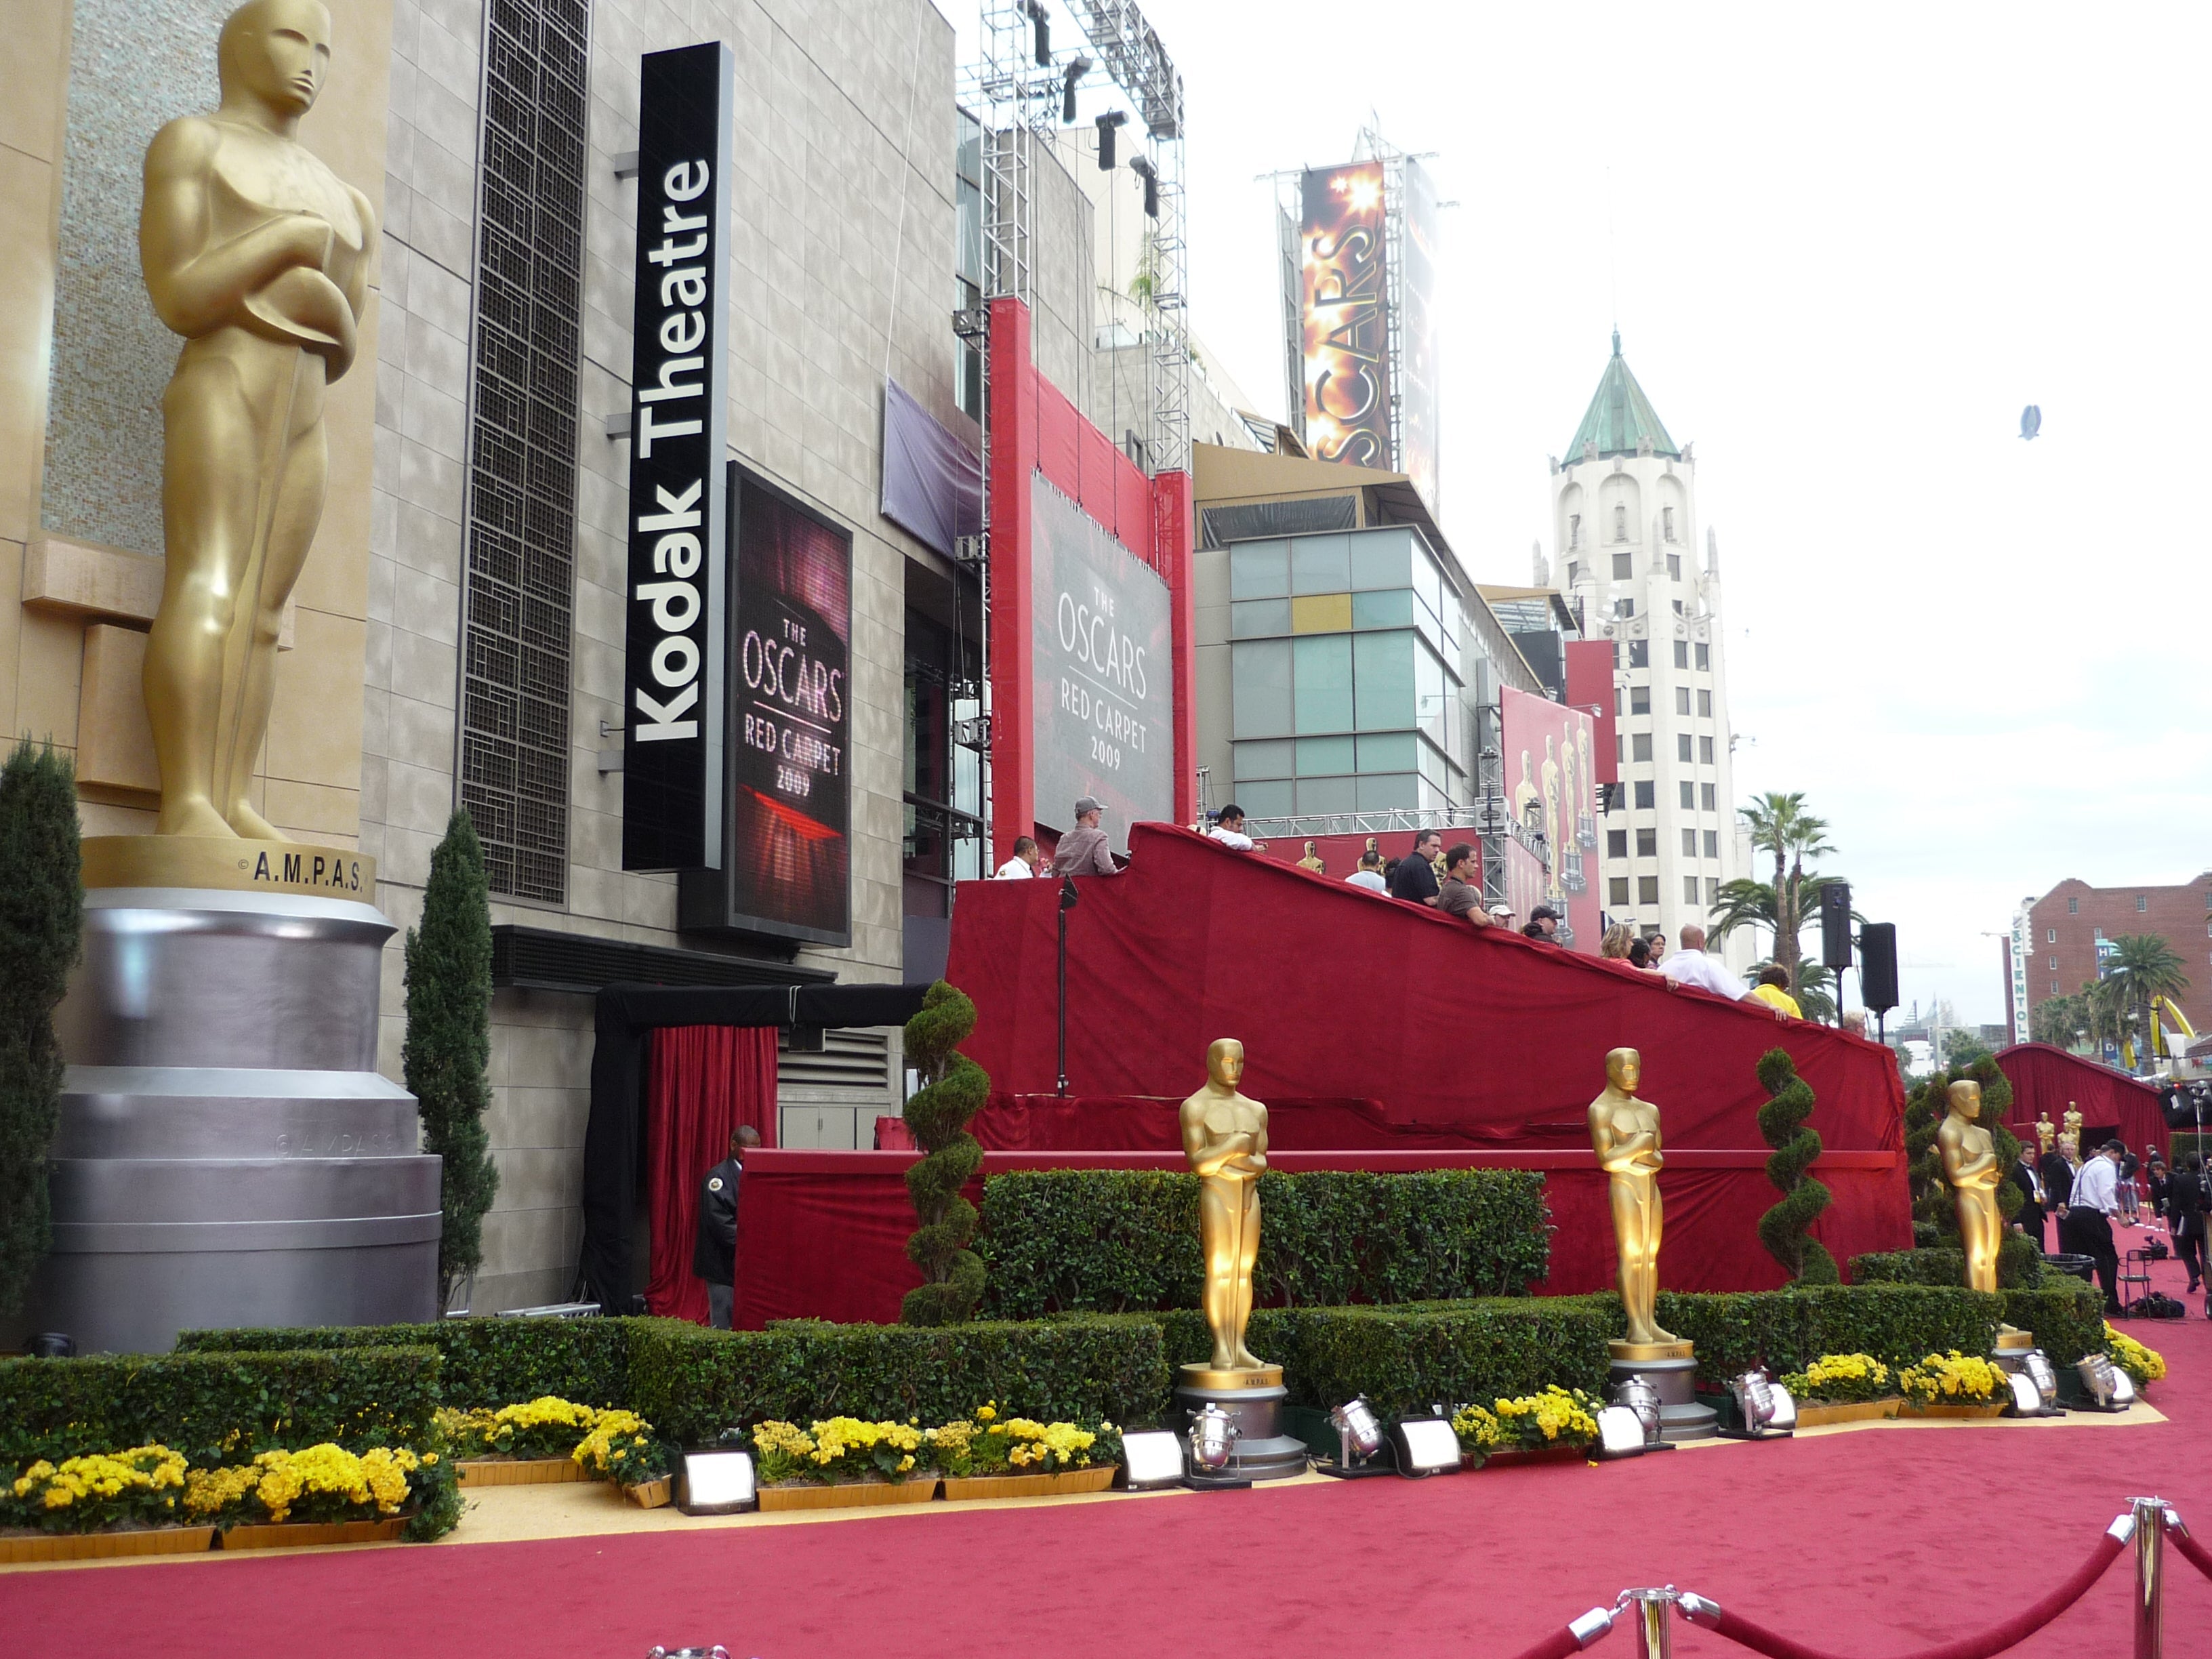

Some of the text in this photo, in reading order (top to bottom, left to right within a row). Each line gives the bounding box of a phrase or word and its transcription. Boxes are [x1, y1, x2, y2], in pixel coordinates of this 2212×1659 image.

[1312, 224, 1382, 468] SCARS
[636, 159, 710, 742] Kodak Theatre
[783, 618, 806, 647] THE
[1094, 586, 1114, 617] THE
[743, 630, 842, 722] OSCARS
[1058, 592, 1147, 699] OSCARS
[745, 713, 840, 775] RED CARPET
[1061, 677, 1147, 753] RED CARPET
[777, 764, 811, 797] 2009
[1092, 736, 1120, 770] 2009
